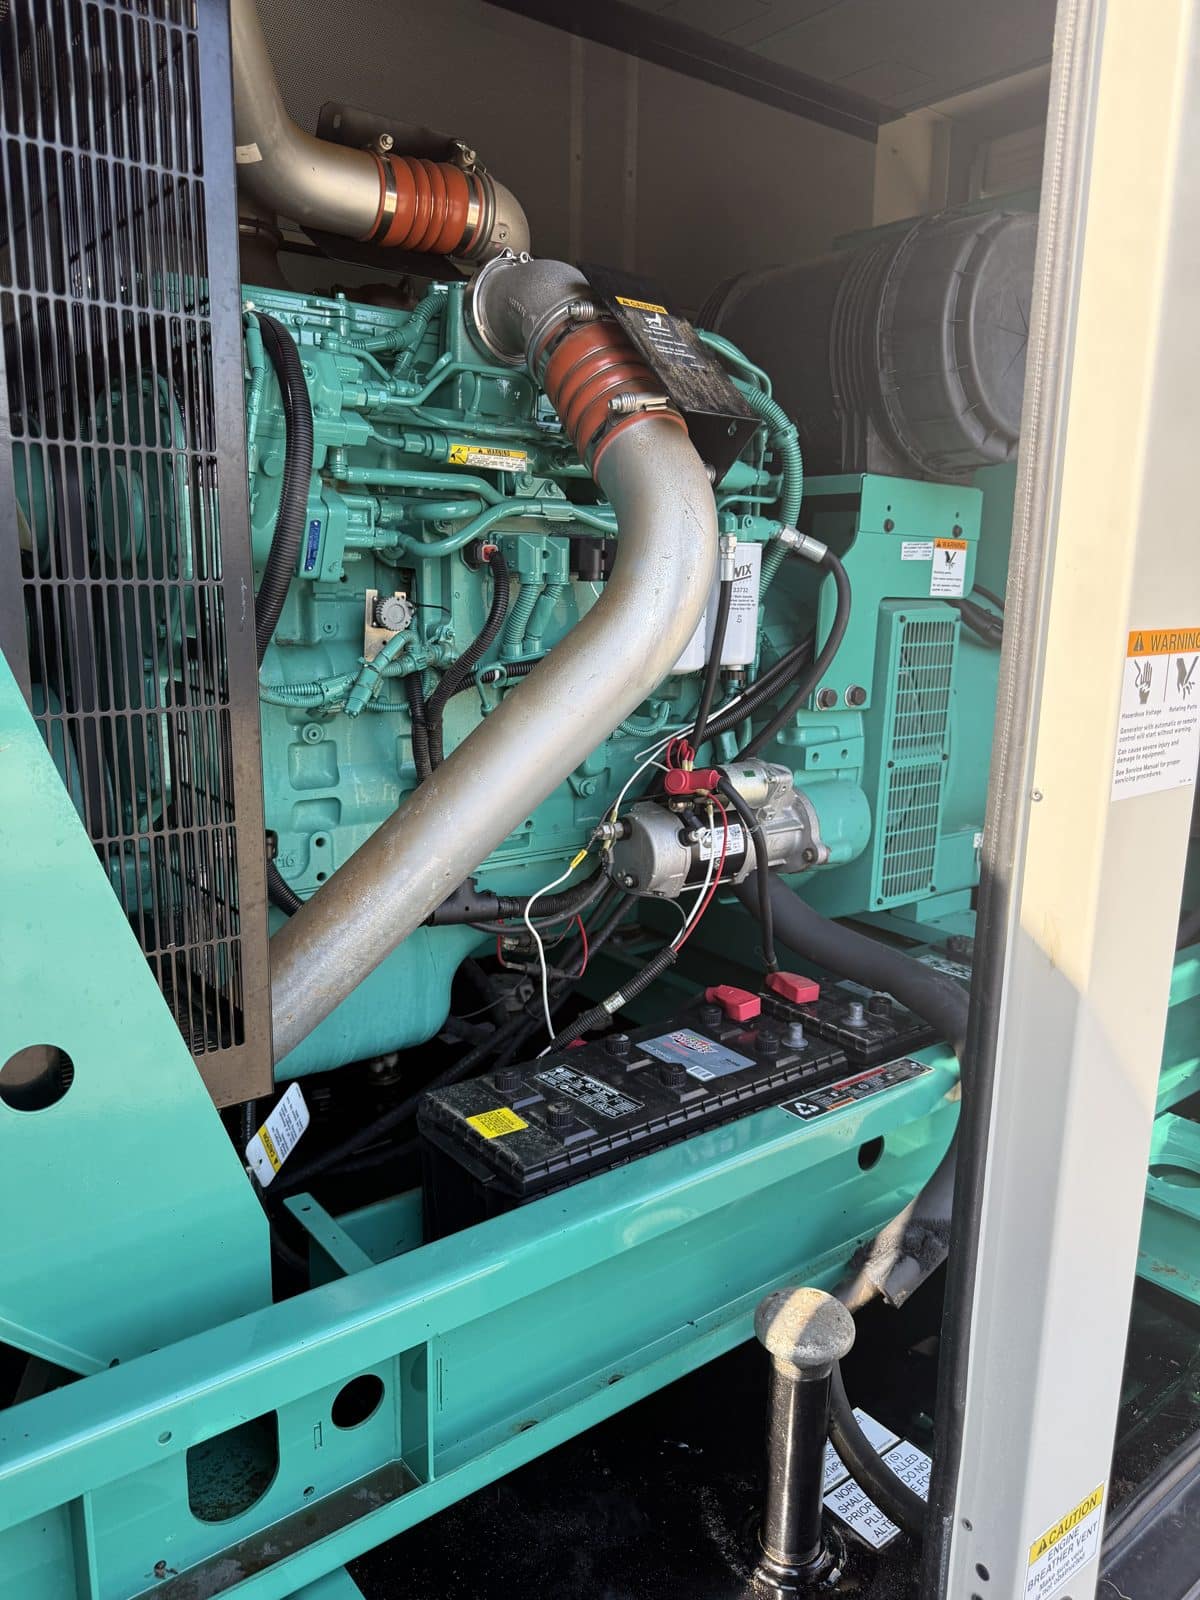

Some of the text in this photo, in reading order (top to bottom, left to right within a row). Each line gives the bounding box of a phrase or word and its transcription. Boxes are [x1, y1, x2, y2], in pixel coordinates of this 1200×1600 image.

[1151, 632, 1200, 652] WARNING
[1119, 734, 1136, 743] control
[1136, 732, 1145, 740] will
[1145, 731, 1157, 739] start
[1157, 728, 1174, 737] without
[1120, 724, 1144, 735] Generator
[1144, 723, 1154, 731] with
[1154, 720, 1177, 729] automatic
[1117, 748, 1127, 756] Can
[1128, 746, 1142, 754] cause
[1142, 744, 1158, 752] severe
[1158, 741, 1171, 750] injury
[1115, 769, 1125, 777] See
[1125, 766, 1143, 775] Service
[1143, 763, 1160, 771] Manual
[1166, 759, 1181, 768] proper
[1116, 755, 1135, 764] damage
[1114, 775, 1136, 785] servicing
[884, 1451, 903, 1466] T(S)
[837, 1453, 920, 1515] SHALL ALLED
[901, 1471, 917, 1484] DO
[863, 1511, 885, 1528] PLU
[1048, 1493, 1098, 1545] CAUTION
[873, 1520, 896, 1539] ALTE
[1047, 1526, 1080, 1562] ENGINE
[1027, 1520, 1098, 1593] BREATHER VENT
[1039, 1546, 1084, 1590] Make sure vent
[1042, 1583, 1054, 1596] not
